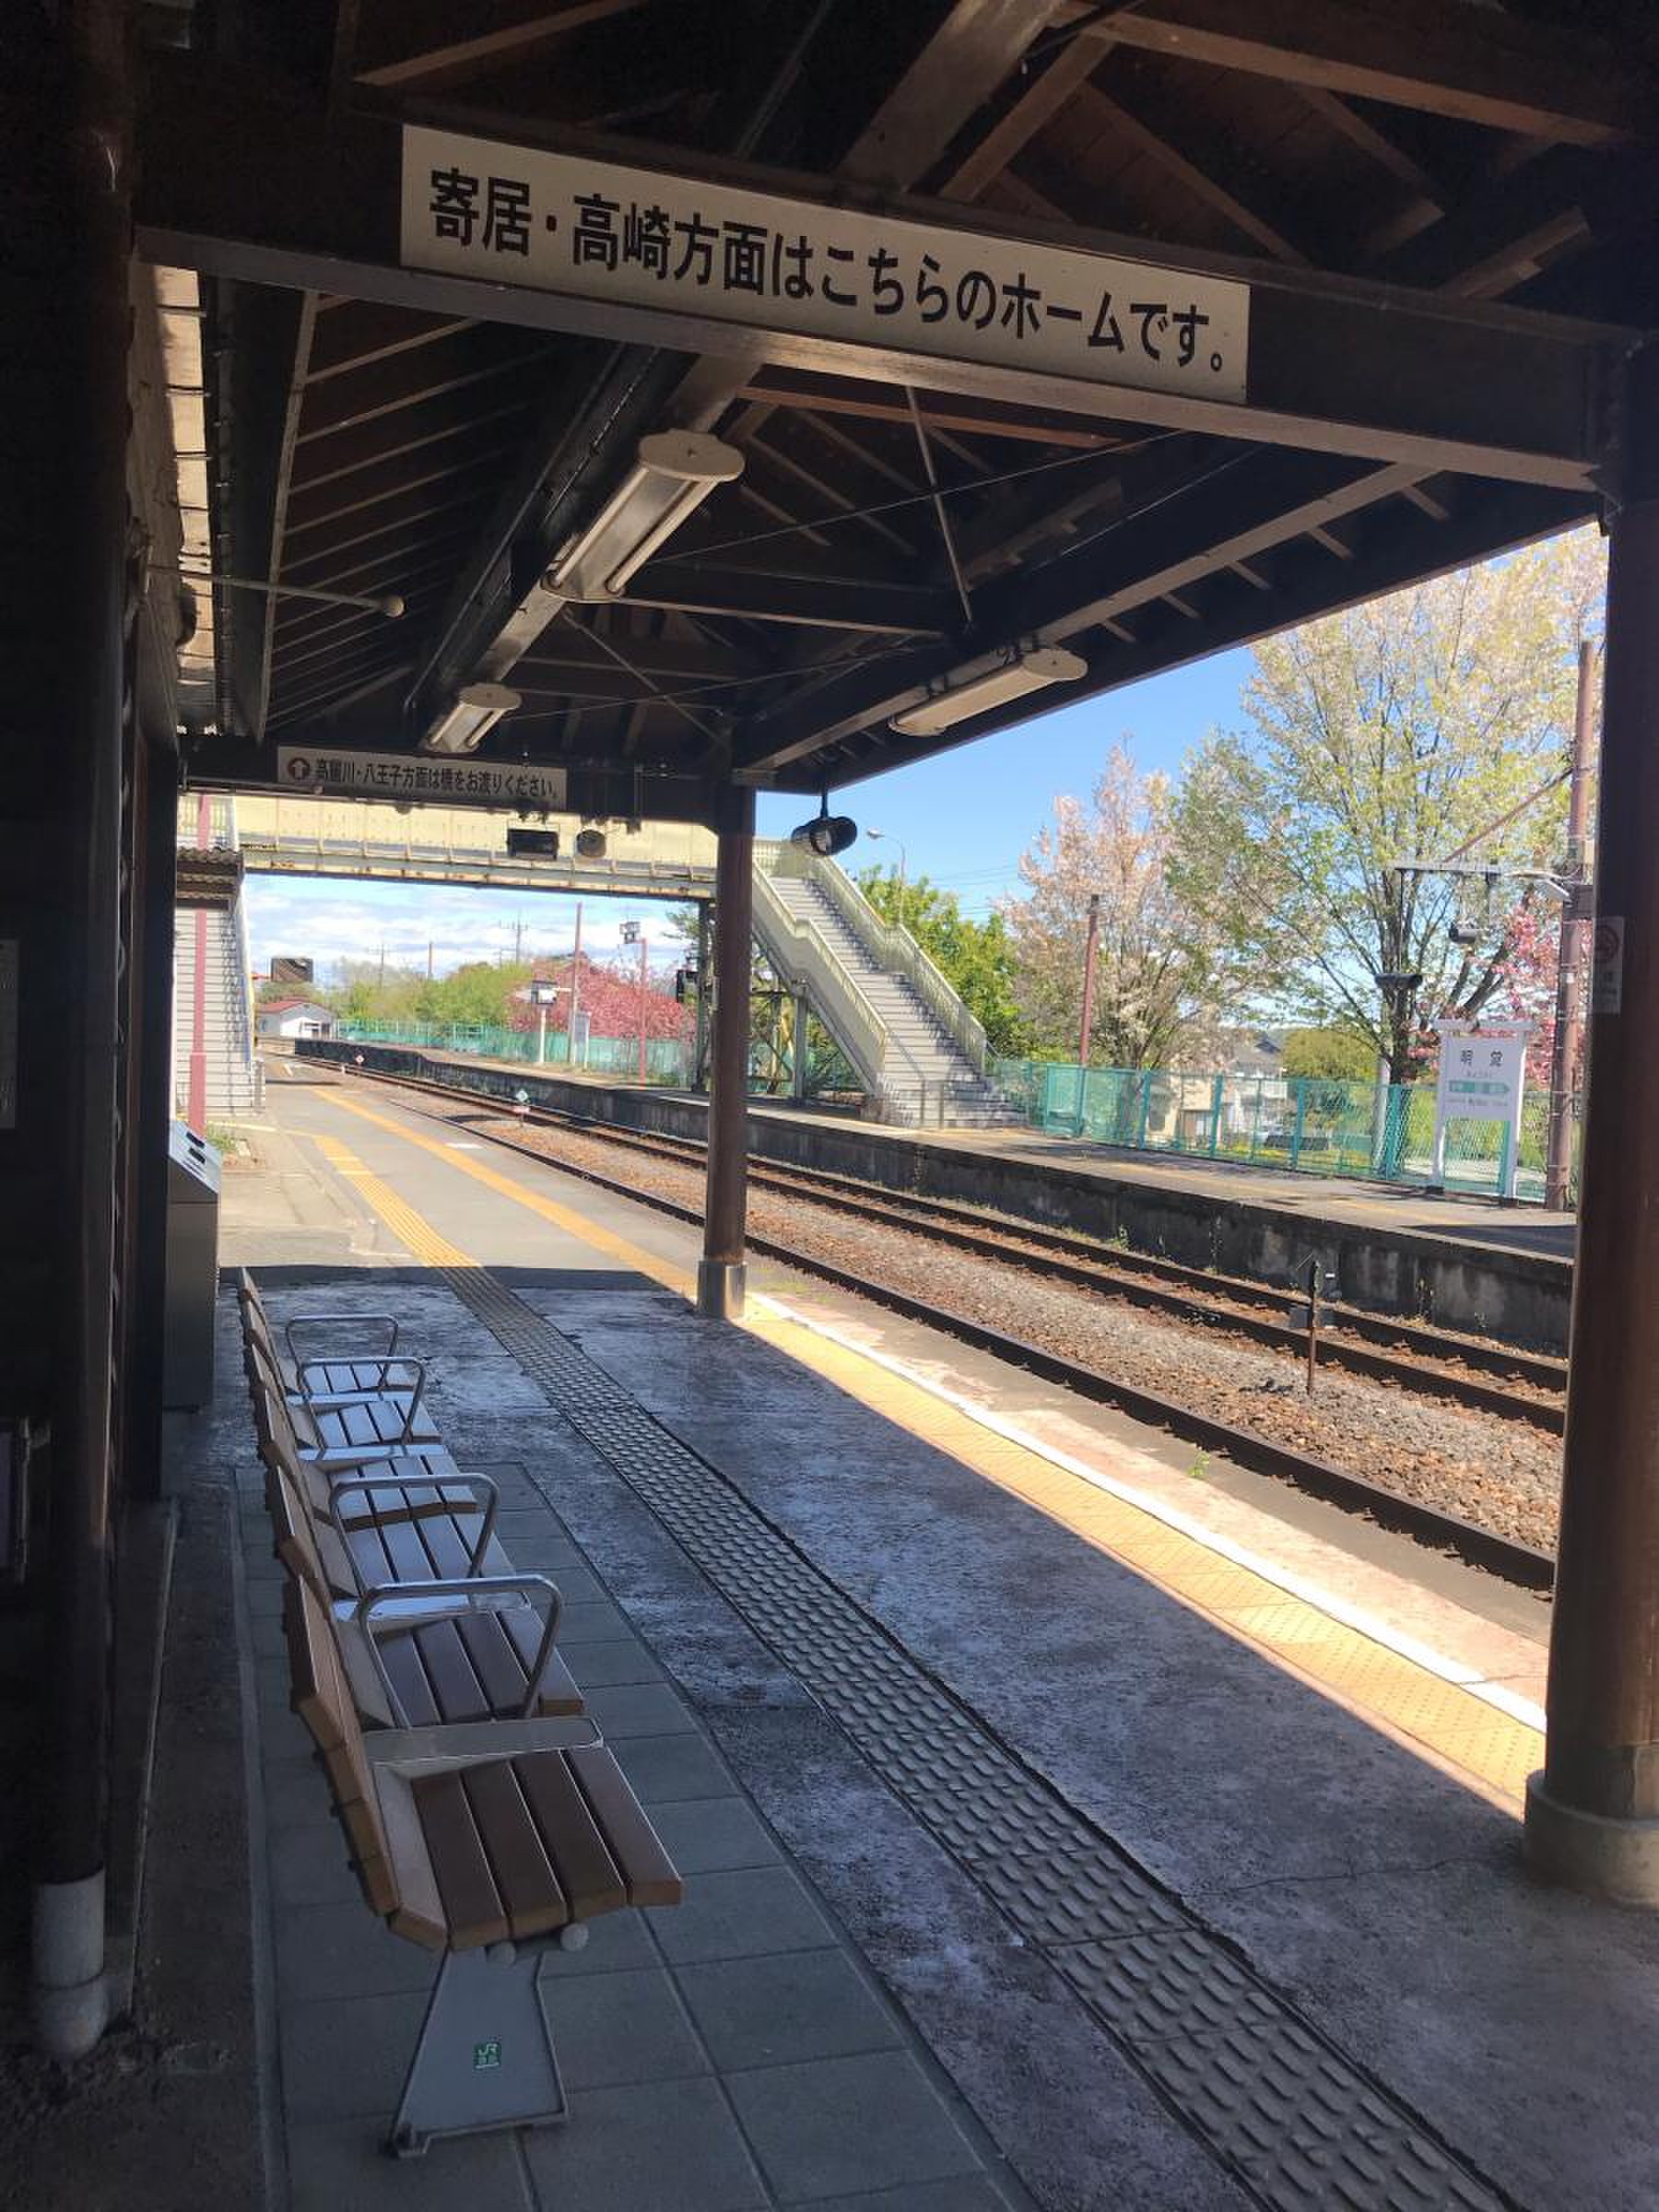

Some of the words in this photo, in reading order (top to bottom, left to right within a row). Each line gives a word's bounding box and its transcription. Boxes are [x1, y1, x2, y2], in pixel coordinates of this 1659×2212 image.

[429, 169, 1224, 372] 寄居・高崎方面はこちらのホームです。
